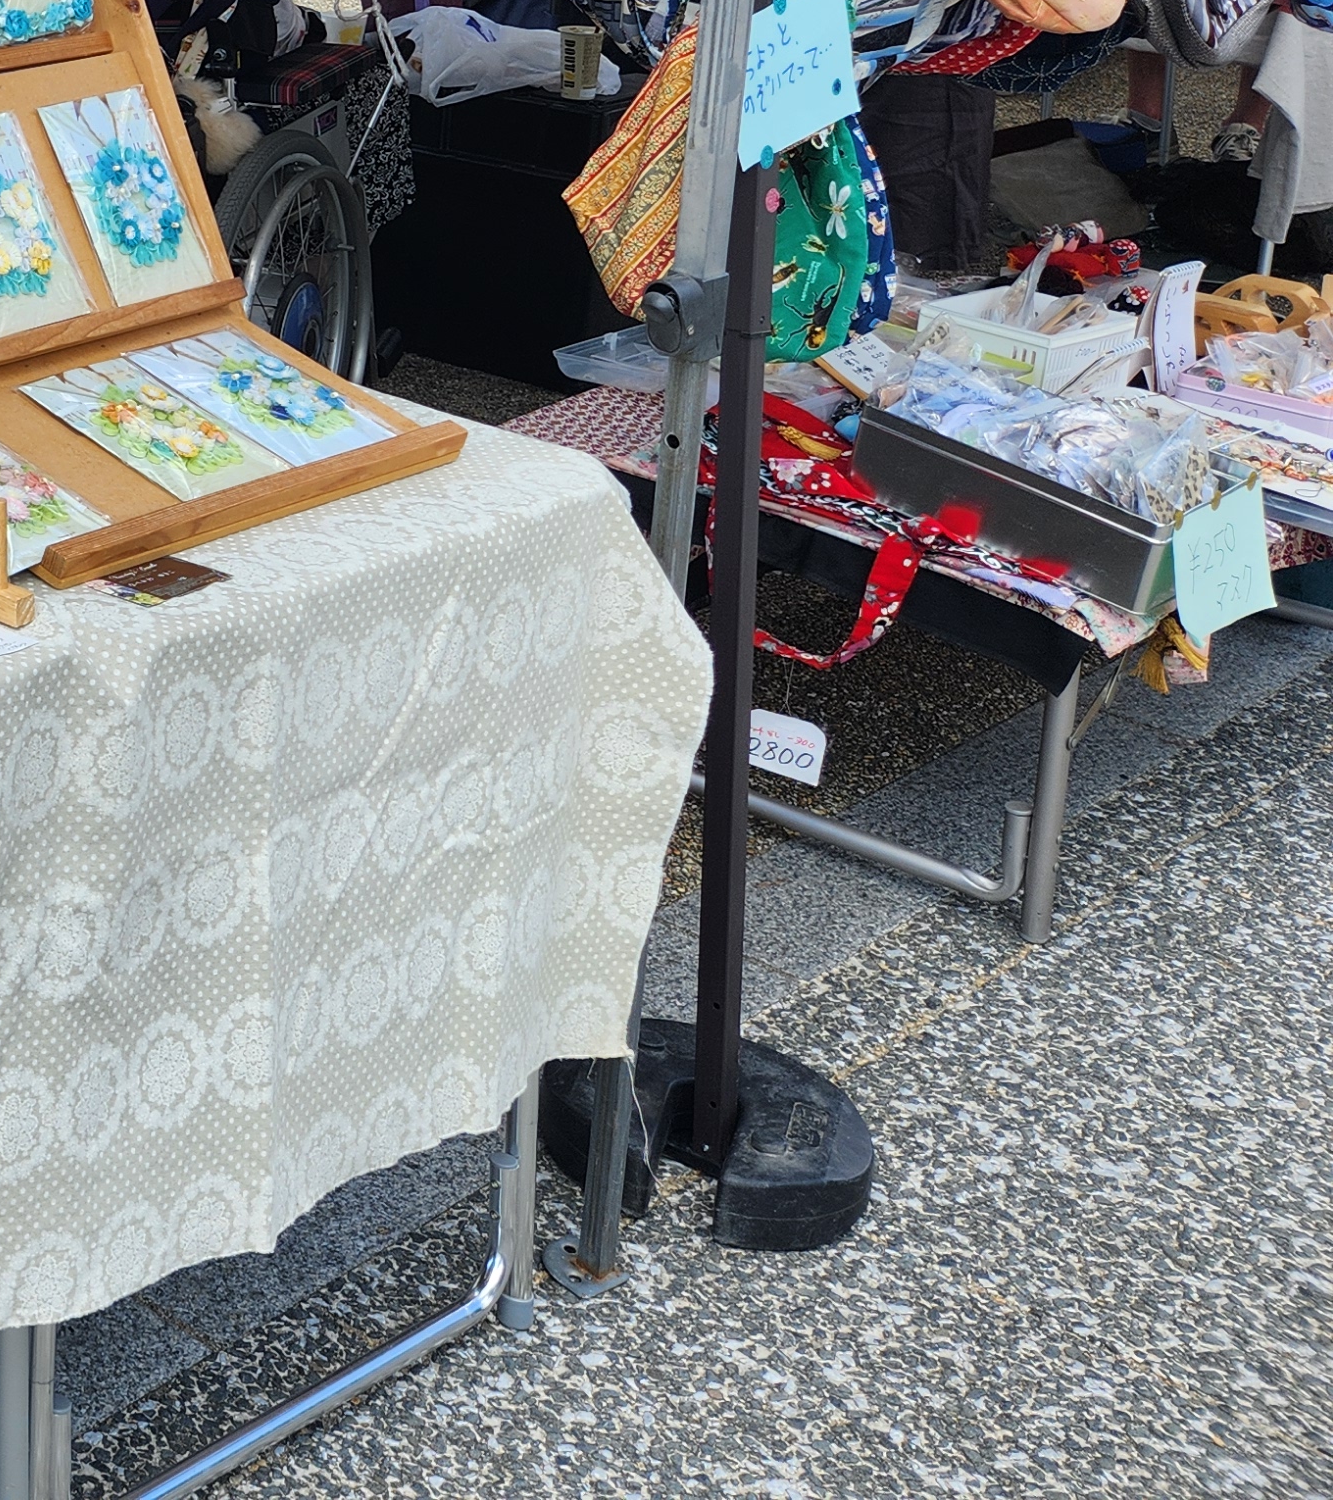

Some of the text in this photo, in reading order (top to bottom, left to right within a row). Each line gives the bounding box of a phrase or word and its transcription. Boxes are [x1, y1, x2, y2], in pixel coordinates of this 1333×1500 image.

[1187, 522, 1236, 595] ¥250
[1216, 564, 1252, 611] マスク
[749, 737, 815, 769] 2800
